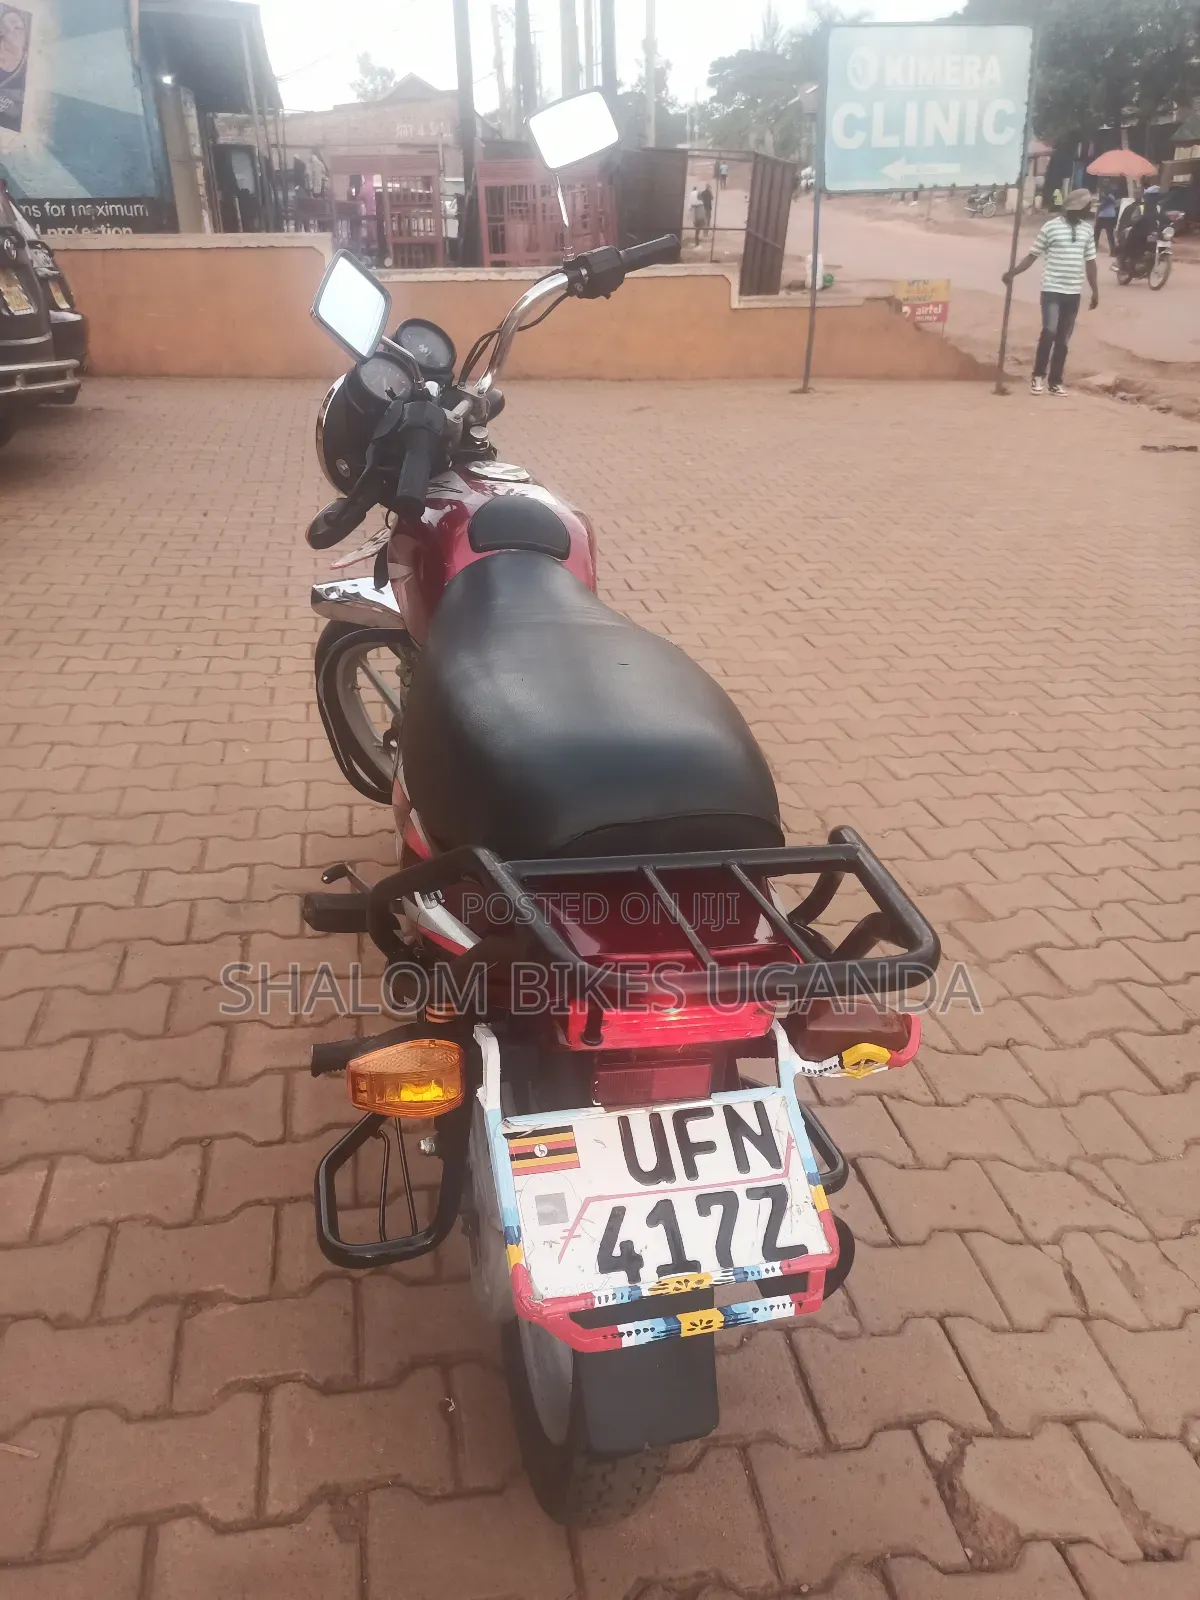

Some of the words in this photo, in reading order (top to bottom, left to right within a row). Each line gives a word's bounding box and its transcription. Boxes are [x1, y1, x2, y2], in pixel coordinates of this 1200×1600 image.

[884, 53, 1003, 86] KIMERA
[831, 98, 1017, 150] CLINIC
[44, 201, 66, 217] for
[915, 303, 942, 316] airtel
[617, 1100, 783, 1186] UFN
[596, 1183, 809, 1284] 417Z
